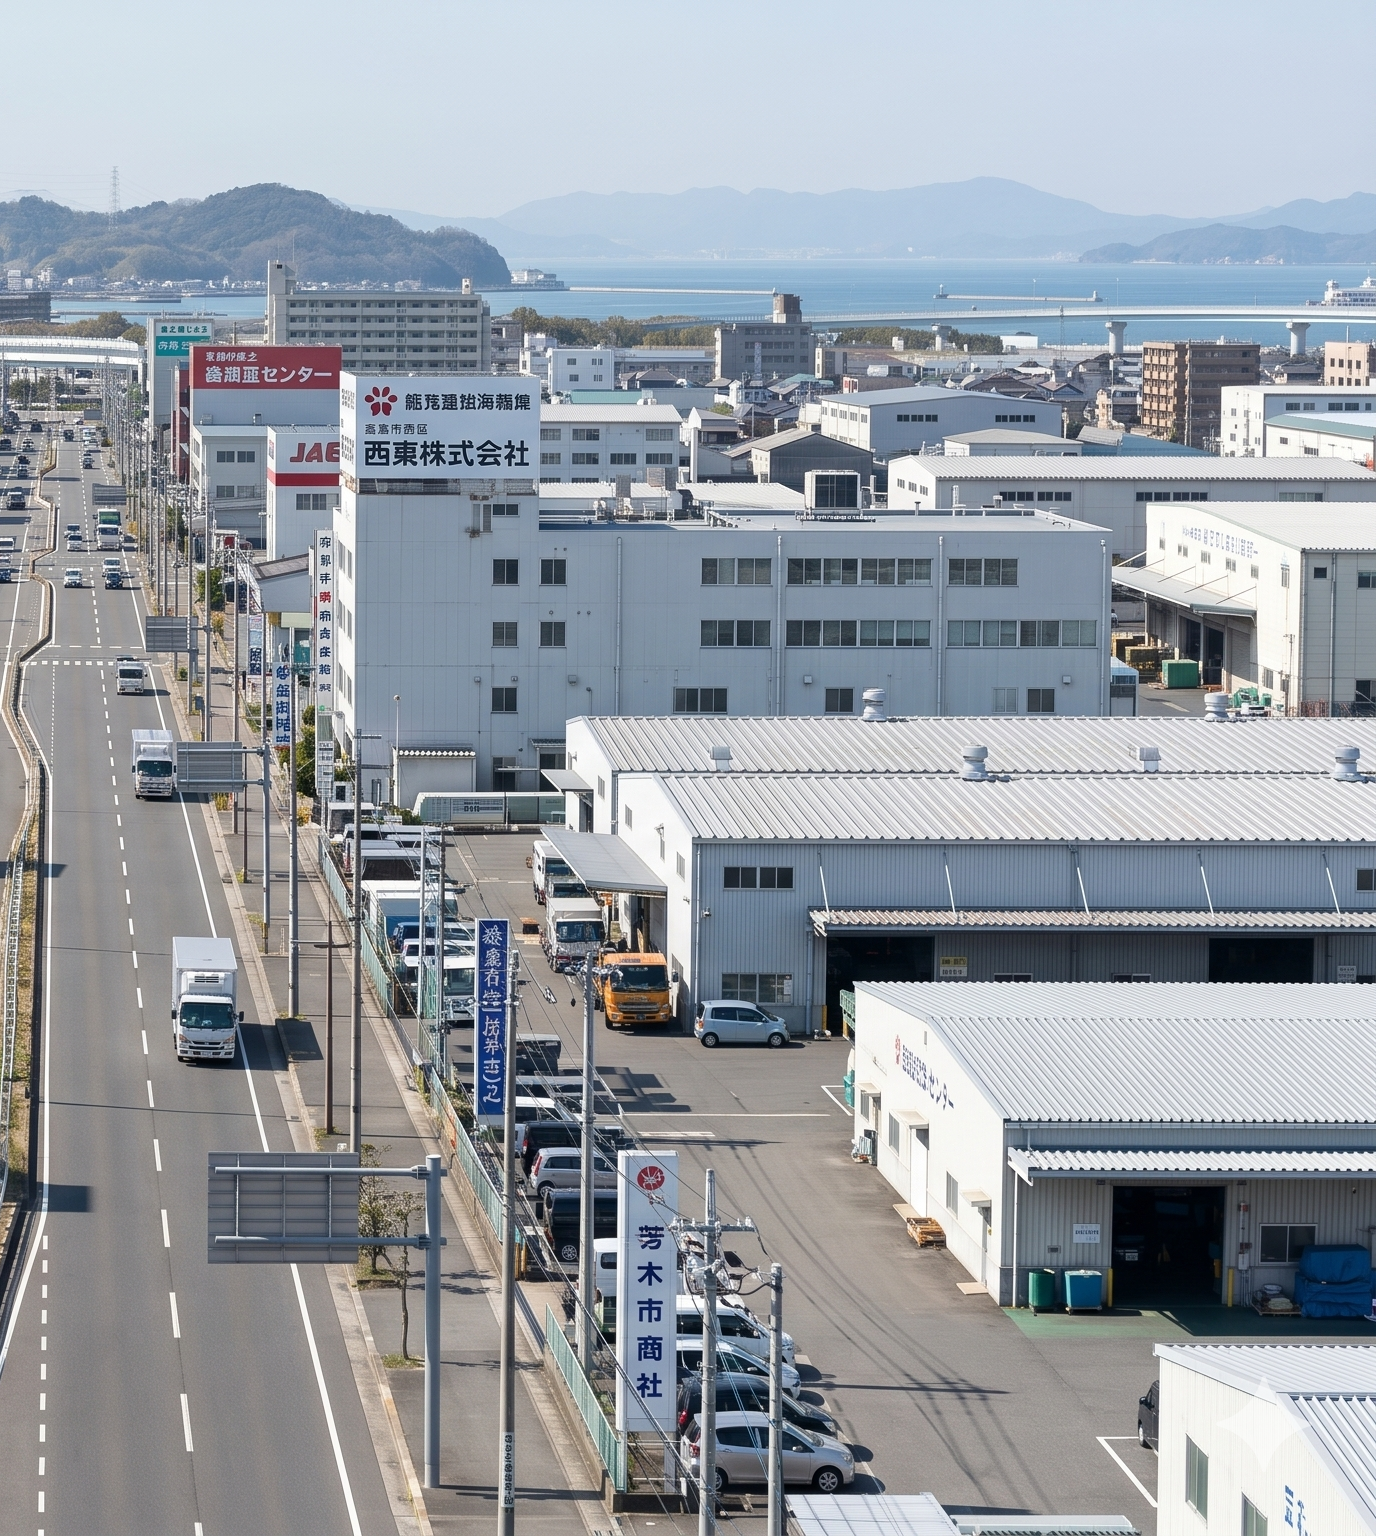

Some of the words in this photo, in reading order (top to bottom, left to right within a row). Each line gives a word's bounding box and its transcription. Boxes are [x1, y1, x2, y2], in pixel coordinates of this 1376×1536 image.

[364, 440, 530, 467] 西東株式会社
